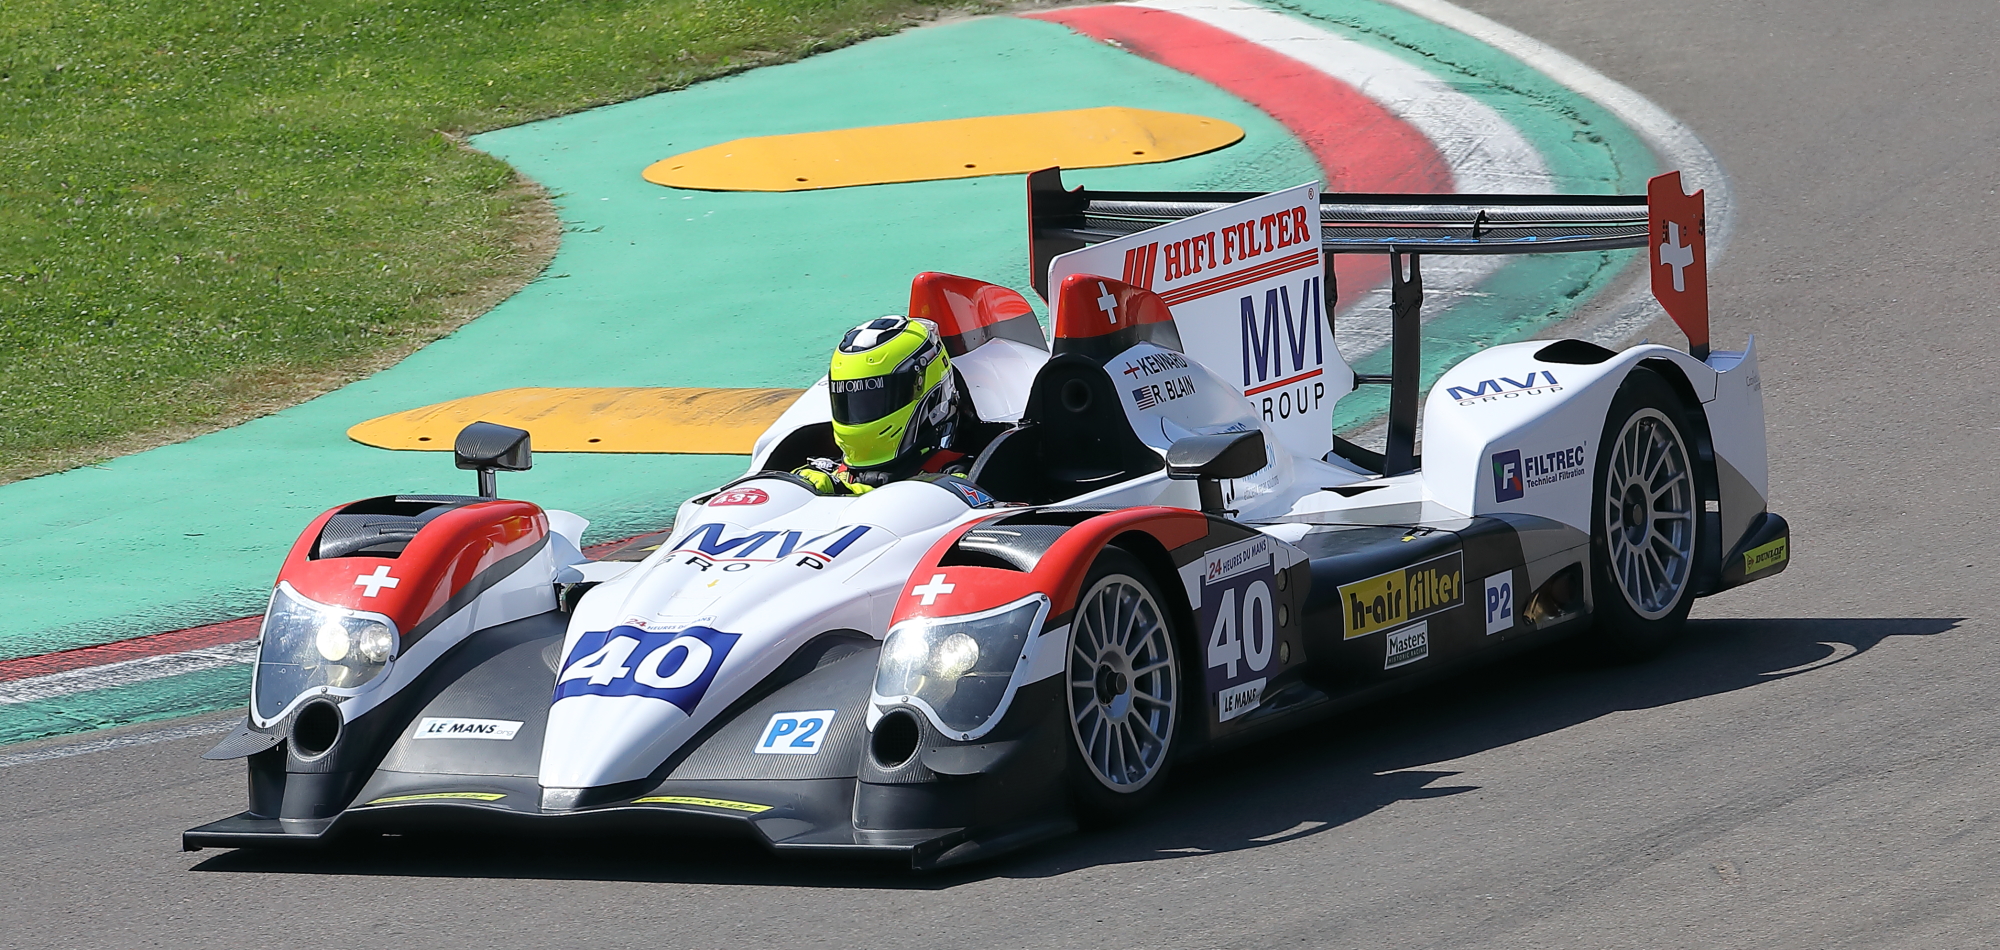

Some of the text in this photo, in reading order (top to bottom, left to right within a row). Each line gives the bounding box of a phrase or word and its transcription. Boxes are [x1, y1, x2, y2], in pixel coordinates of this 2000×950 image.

[1164, 205, 1310, 281] HIFI FILTER
[1240, 276, 1323, 387] MVI
[1136, 352, 1188, 377] KENNARD
[1150, 375, 1196, 404] R. BLAIN
[1446, 370, 1558, 400] MVI
[1459, 386, 1563, 406] GROUP
[1250, 382, 1325, 422] ROUP
[1502, 462, 1515, 490] F
[1525, 445, 1585, 478] FILTREC
[1526, 468, 1585, 488] Technical Filtration
[671, 523, 872, 559] MVI
[1755, 545, 1785, 564] DUNLOP
[1208, 539, 1267, 580] 24 HEURES DU MANS
[1350, 568, 1461, 630] h-air filter
[1487, 582, 1512, 624] P2
[625, 618, 648, 627] 24
[1207, 579, 1275, 679] 40
[1388, 647, 1426, 663] HISTORIC RACING
[1389, 631, 1426, 655] Masters
[558, 633, 713, 689] 40
[1224, 695, 1233, 712] LE
[1234, 688, 1257, 710] MANS
[427, 723, 447, 733] LE
[763, 717, 825, 748] P2
